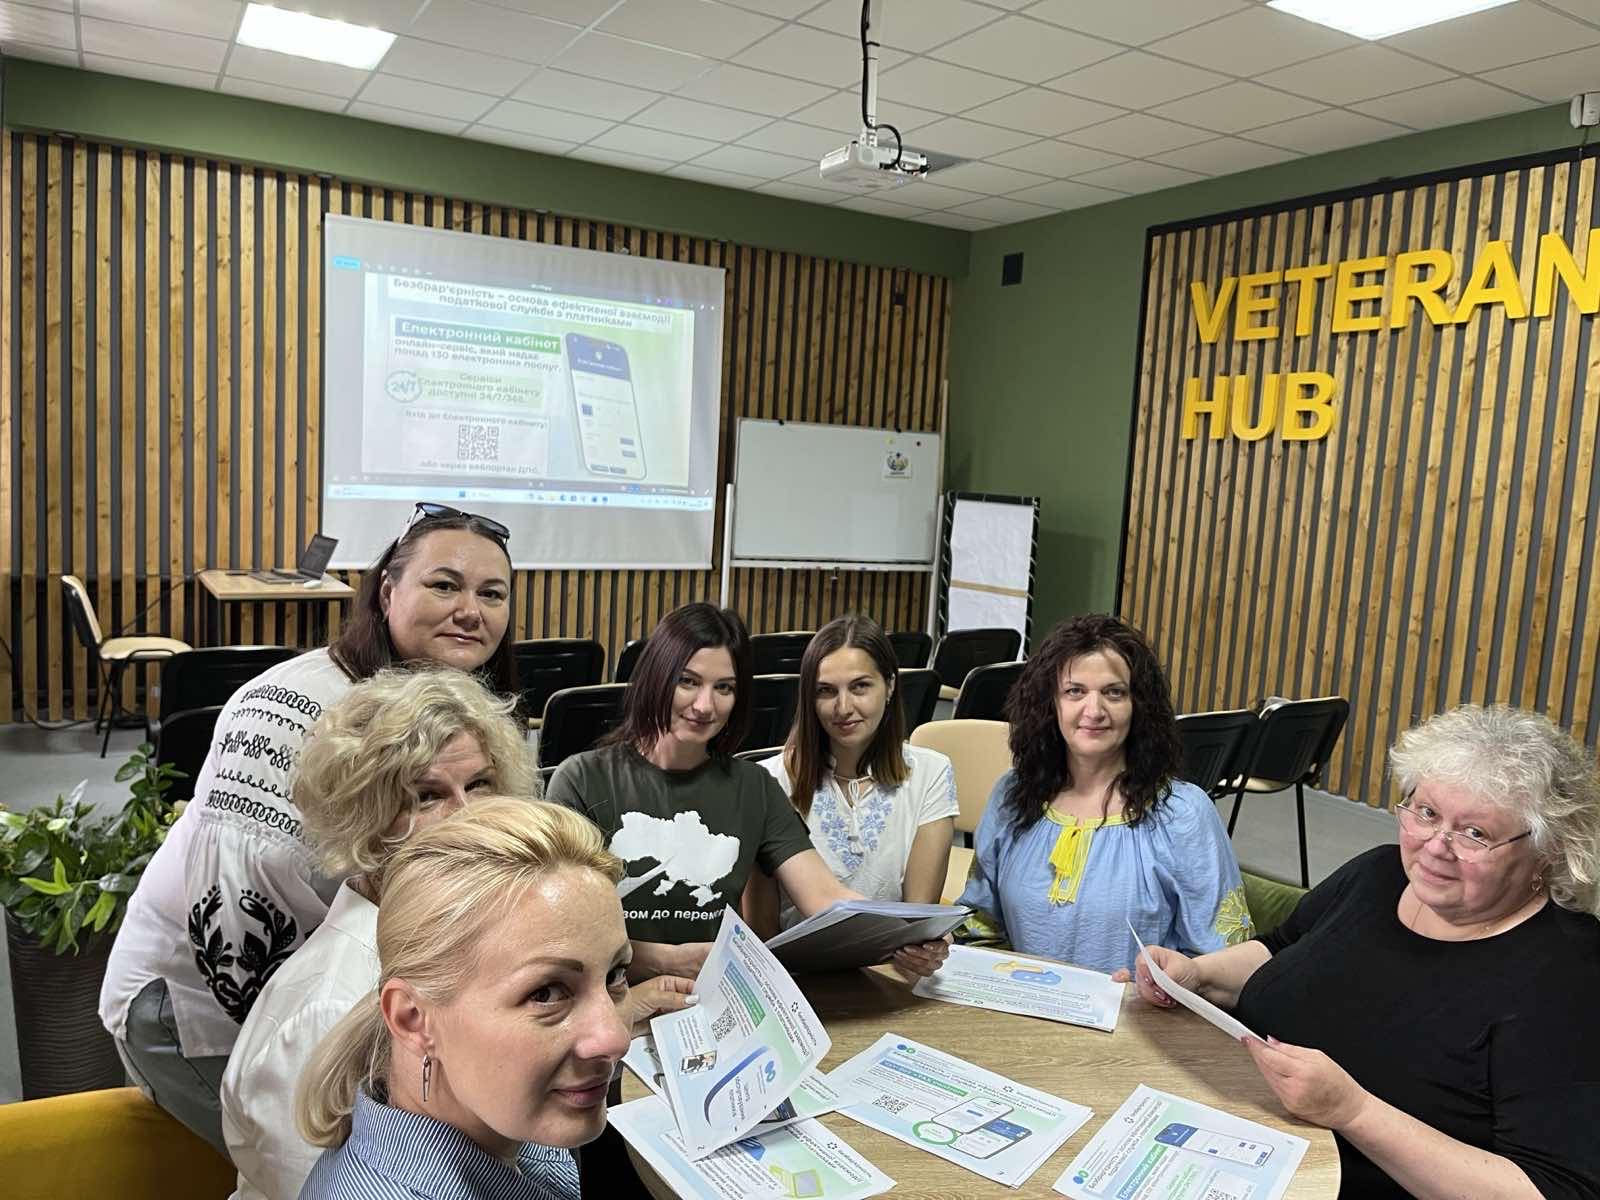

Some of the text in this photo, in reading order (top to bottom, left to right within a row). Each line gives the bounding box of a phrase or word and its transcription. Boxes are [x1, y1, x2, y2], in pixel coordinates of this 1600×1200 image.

[508, 294, 549, 306] основа
[1190, 228, 1600, 344] VETERAN
[440, 295, 507, 312] податкової
[511, 302, 555, 317] служби
[566, 311, 632, 328] платниками
[401, 320, 501, 343] Електронний
[1182, 371, 1337, 442] HUB
[623, 910, 648, 920] зом
[651, 910, 670, 921] до
